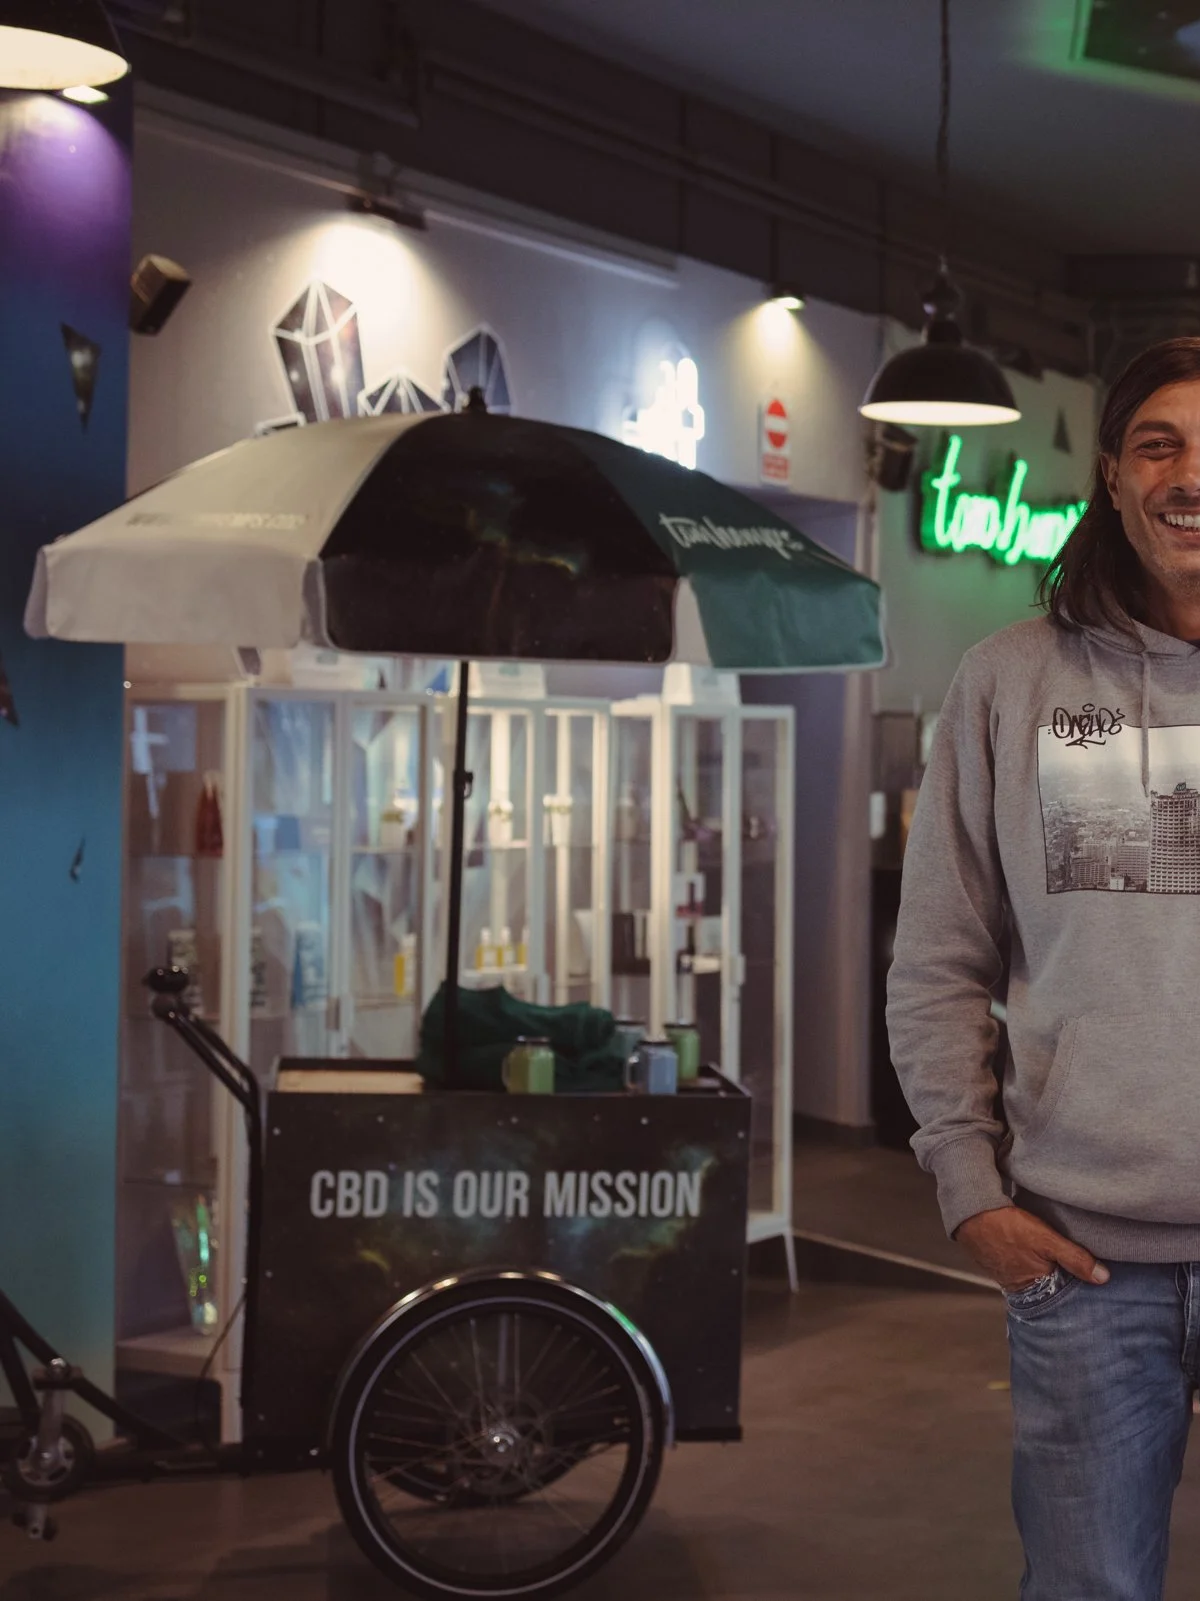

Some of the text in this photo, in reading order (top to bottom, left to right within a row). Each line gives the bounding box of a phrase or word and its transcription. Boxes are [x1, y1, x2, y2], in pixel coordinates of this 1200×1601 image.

[310, 1170, 701, 1218] CBD IS OUR MISSION
